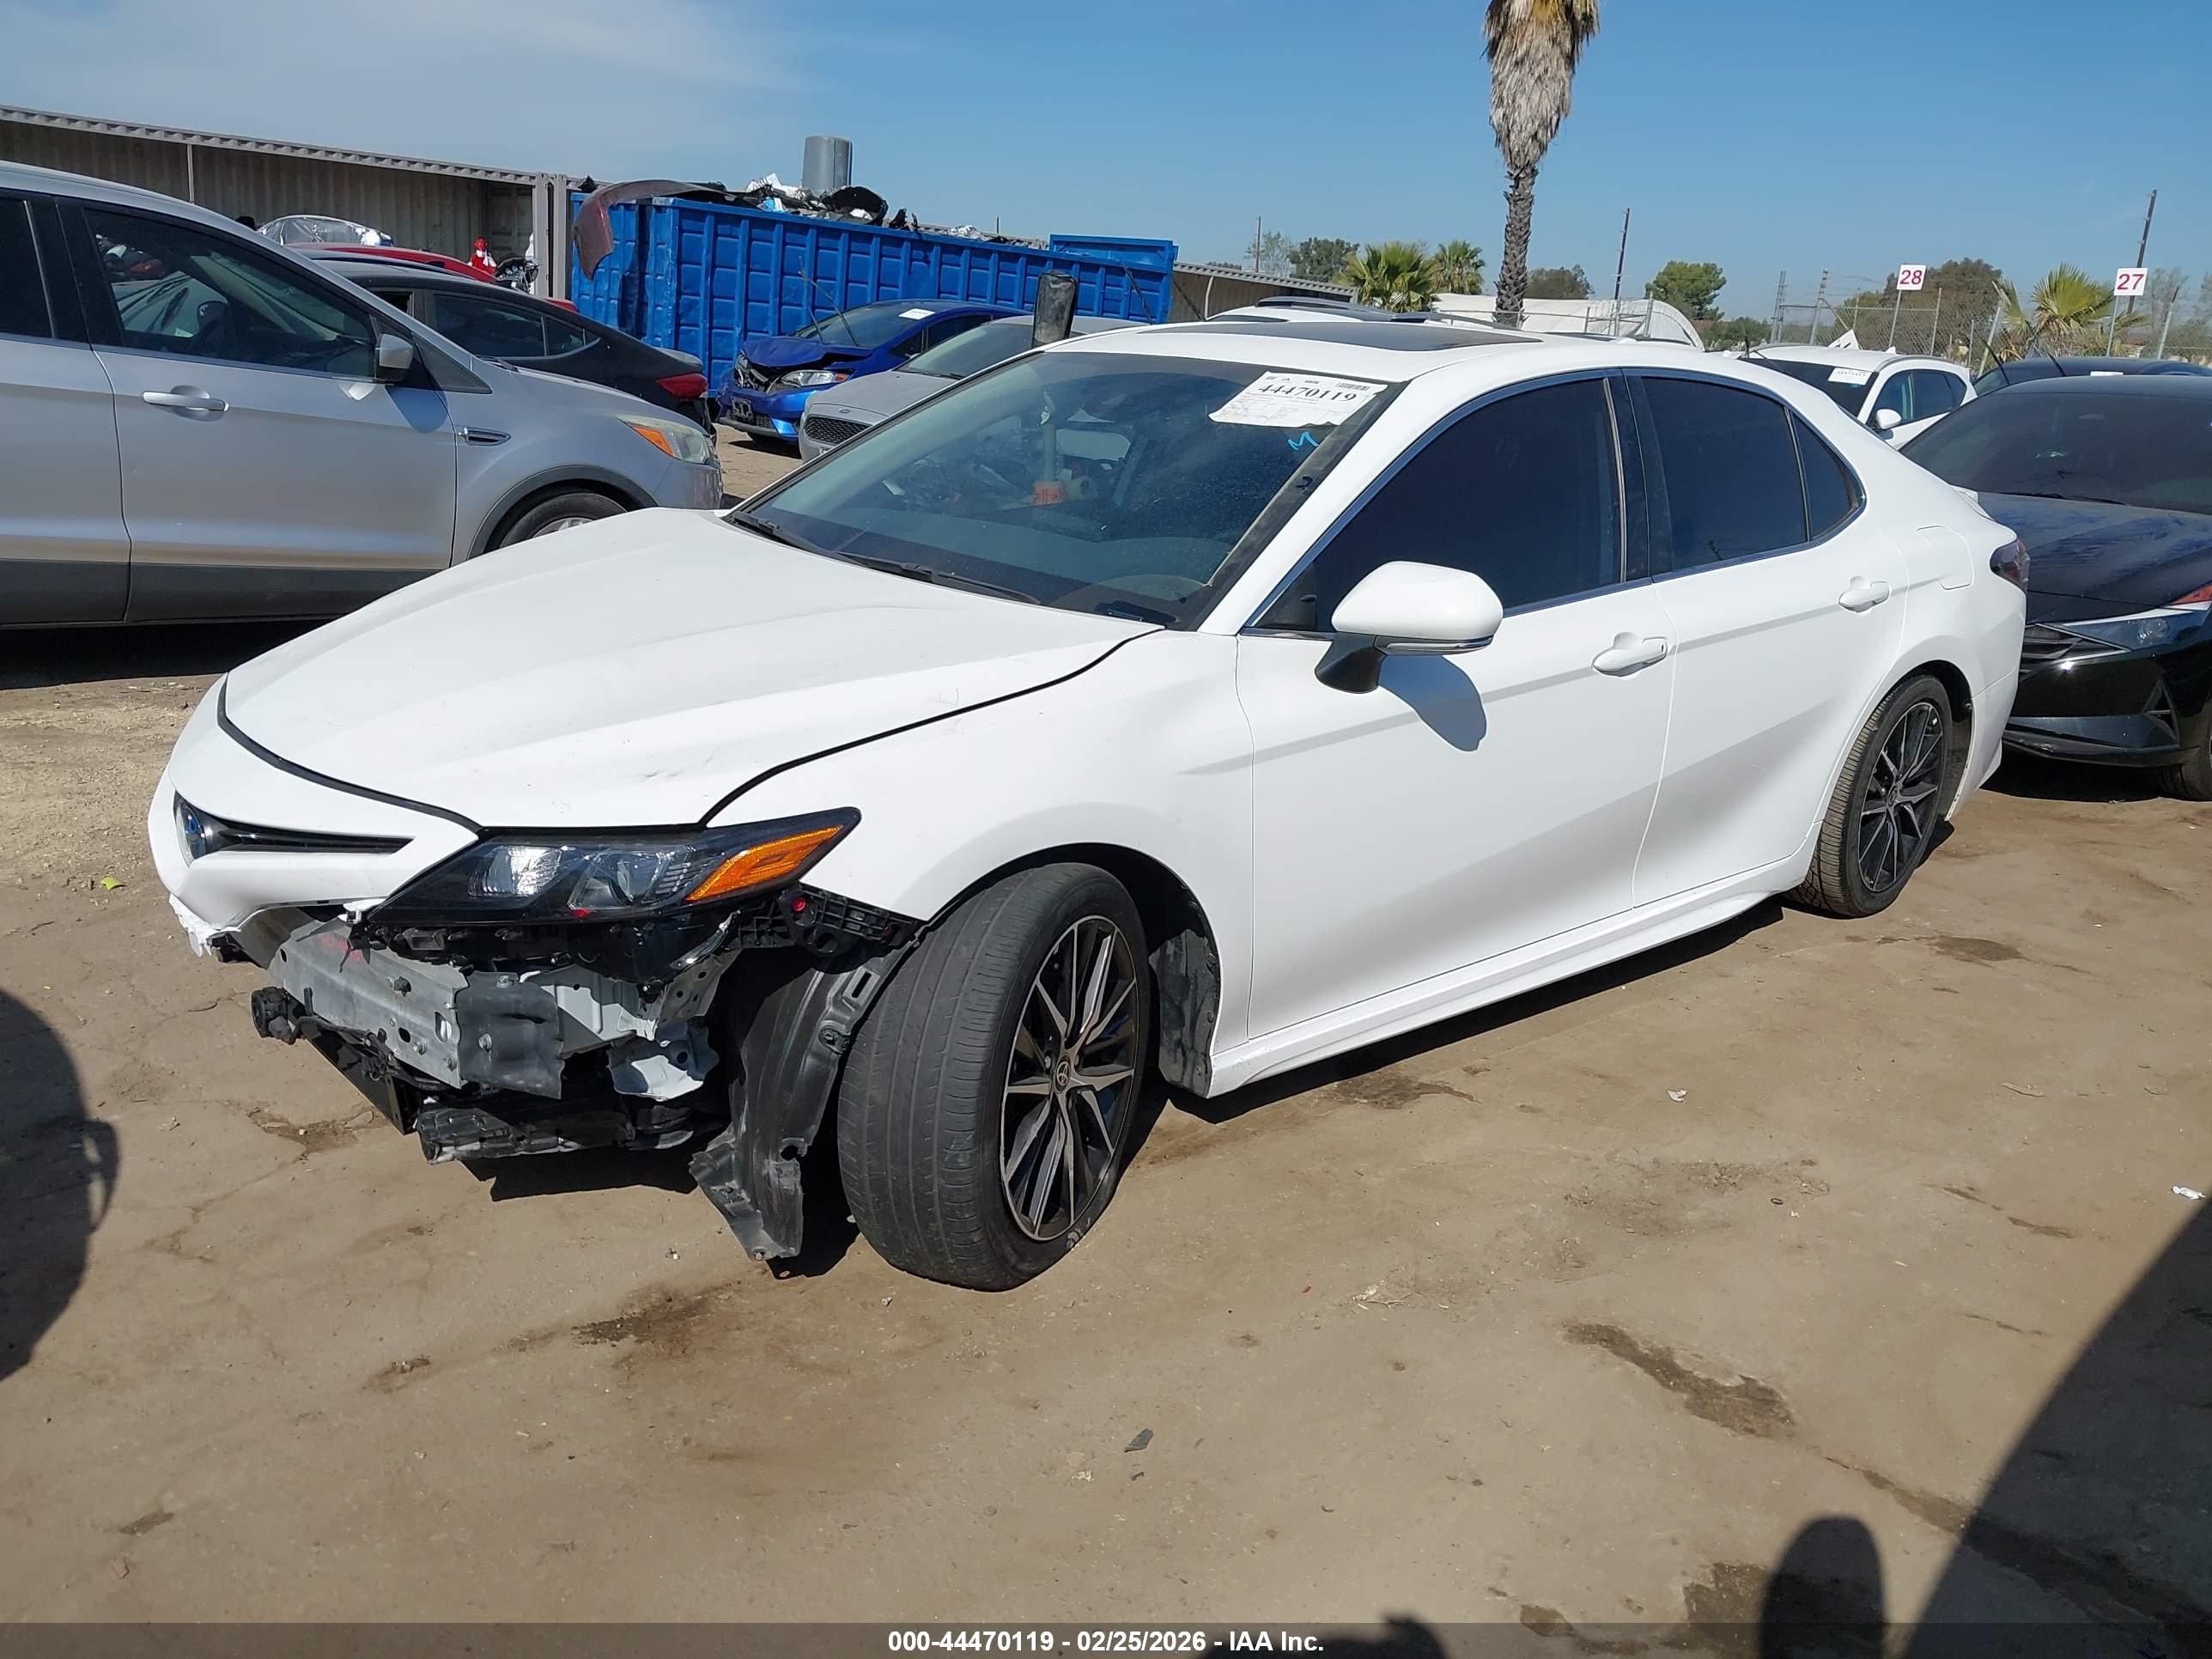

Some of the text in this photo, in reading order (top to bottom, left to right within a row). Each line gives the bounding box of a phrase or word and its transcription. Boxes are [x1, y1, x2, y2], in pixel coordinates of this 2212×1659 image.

[1900, 270, 1923, 285] 28
[2118, 274, 2144, 290] 27
[1258, 384, 1357, 402] 44470119
